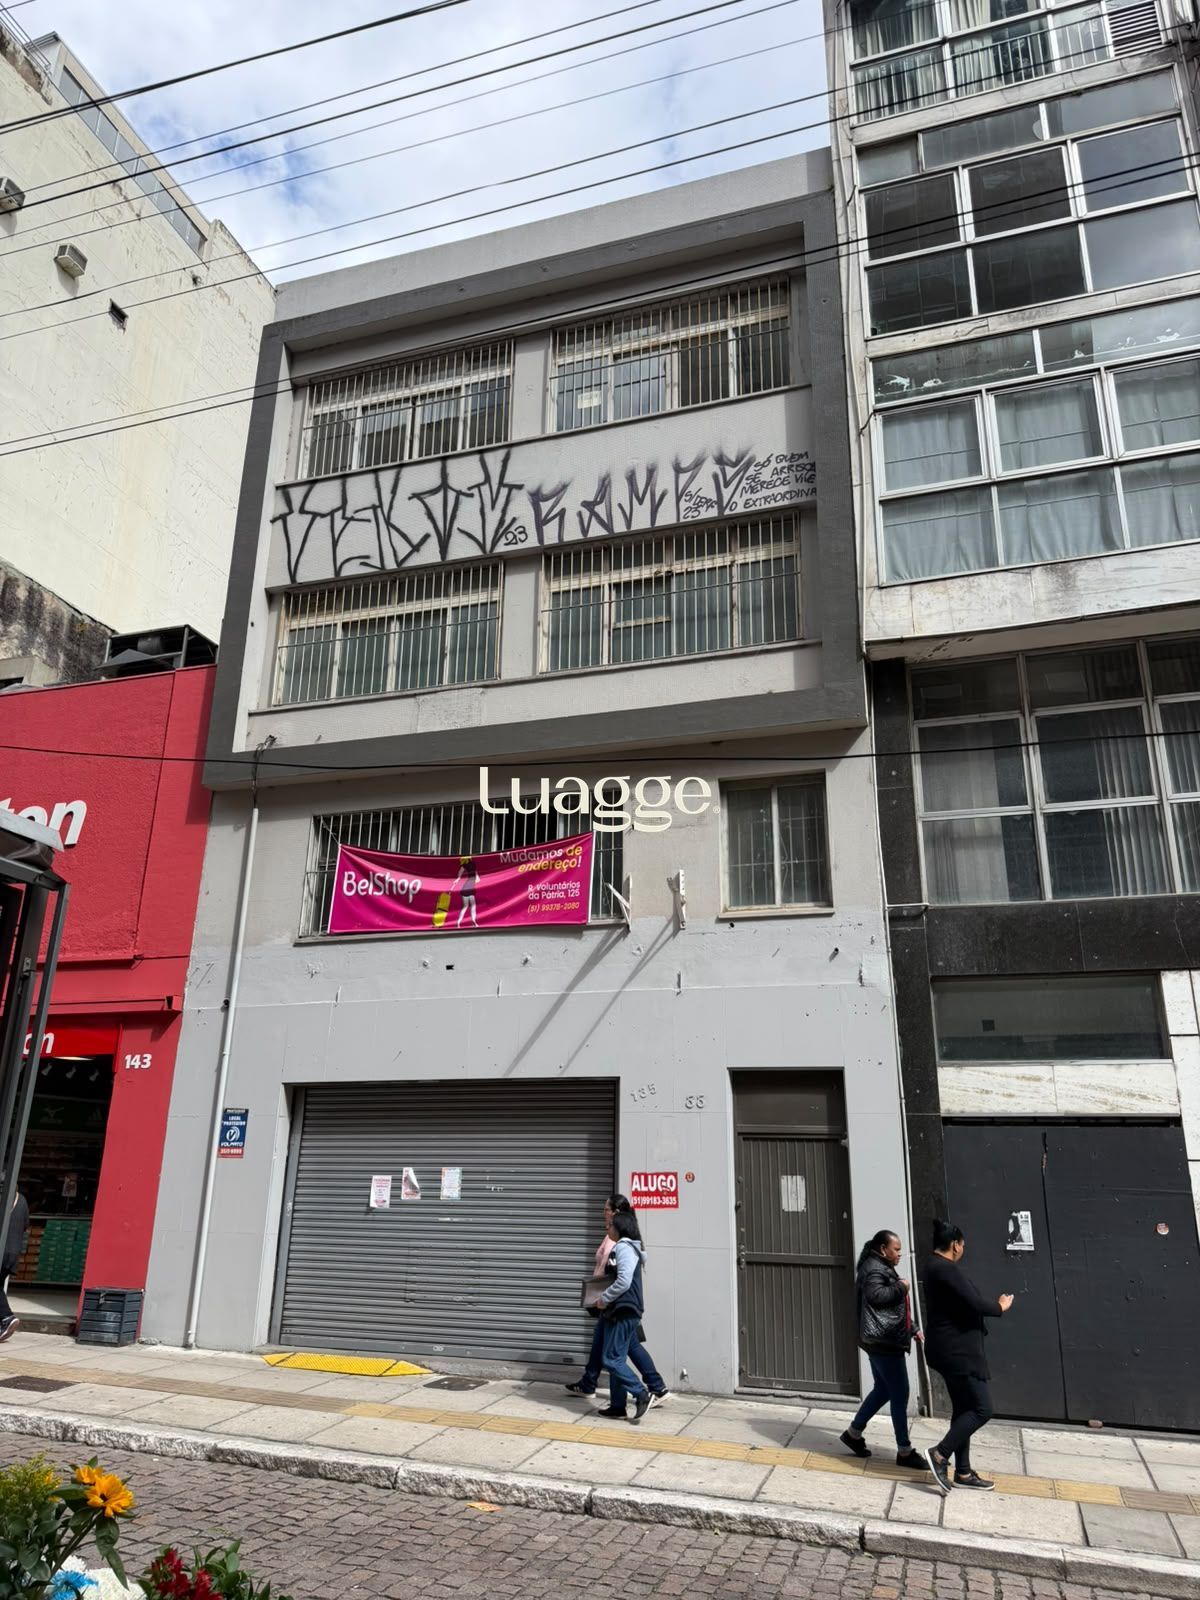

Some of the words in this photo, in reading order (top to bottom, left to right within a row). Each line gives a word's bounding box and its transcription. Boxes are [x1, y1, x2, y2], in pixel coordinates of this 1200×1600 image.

[775, 451, 809, 464] QUEM
[740, 475, 792, 498] MERECE
[745, 472, 762, 485] SE
[503, 525, 528, 547] 23
[499, 848, 564, 864] Mudamos
[566, 844, 583, 857] de
[343, 871, 422, 904] BelShop
[536, 881, 581, 891] Voluntários
[528, 891, 540, 900] da
[125, 1054, 152, 1069] 143
[632, 1174, 677, 1192] ALUGO
